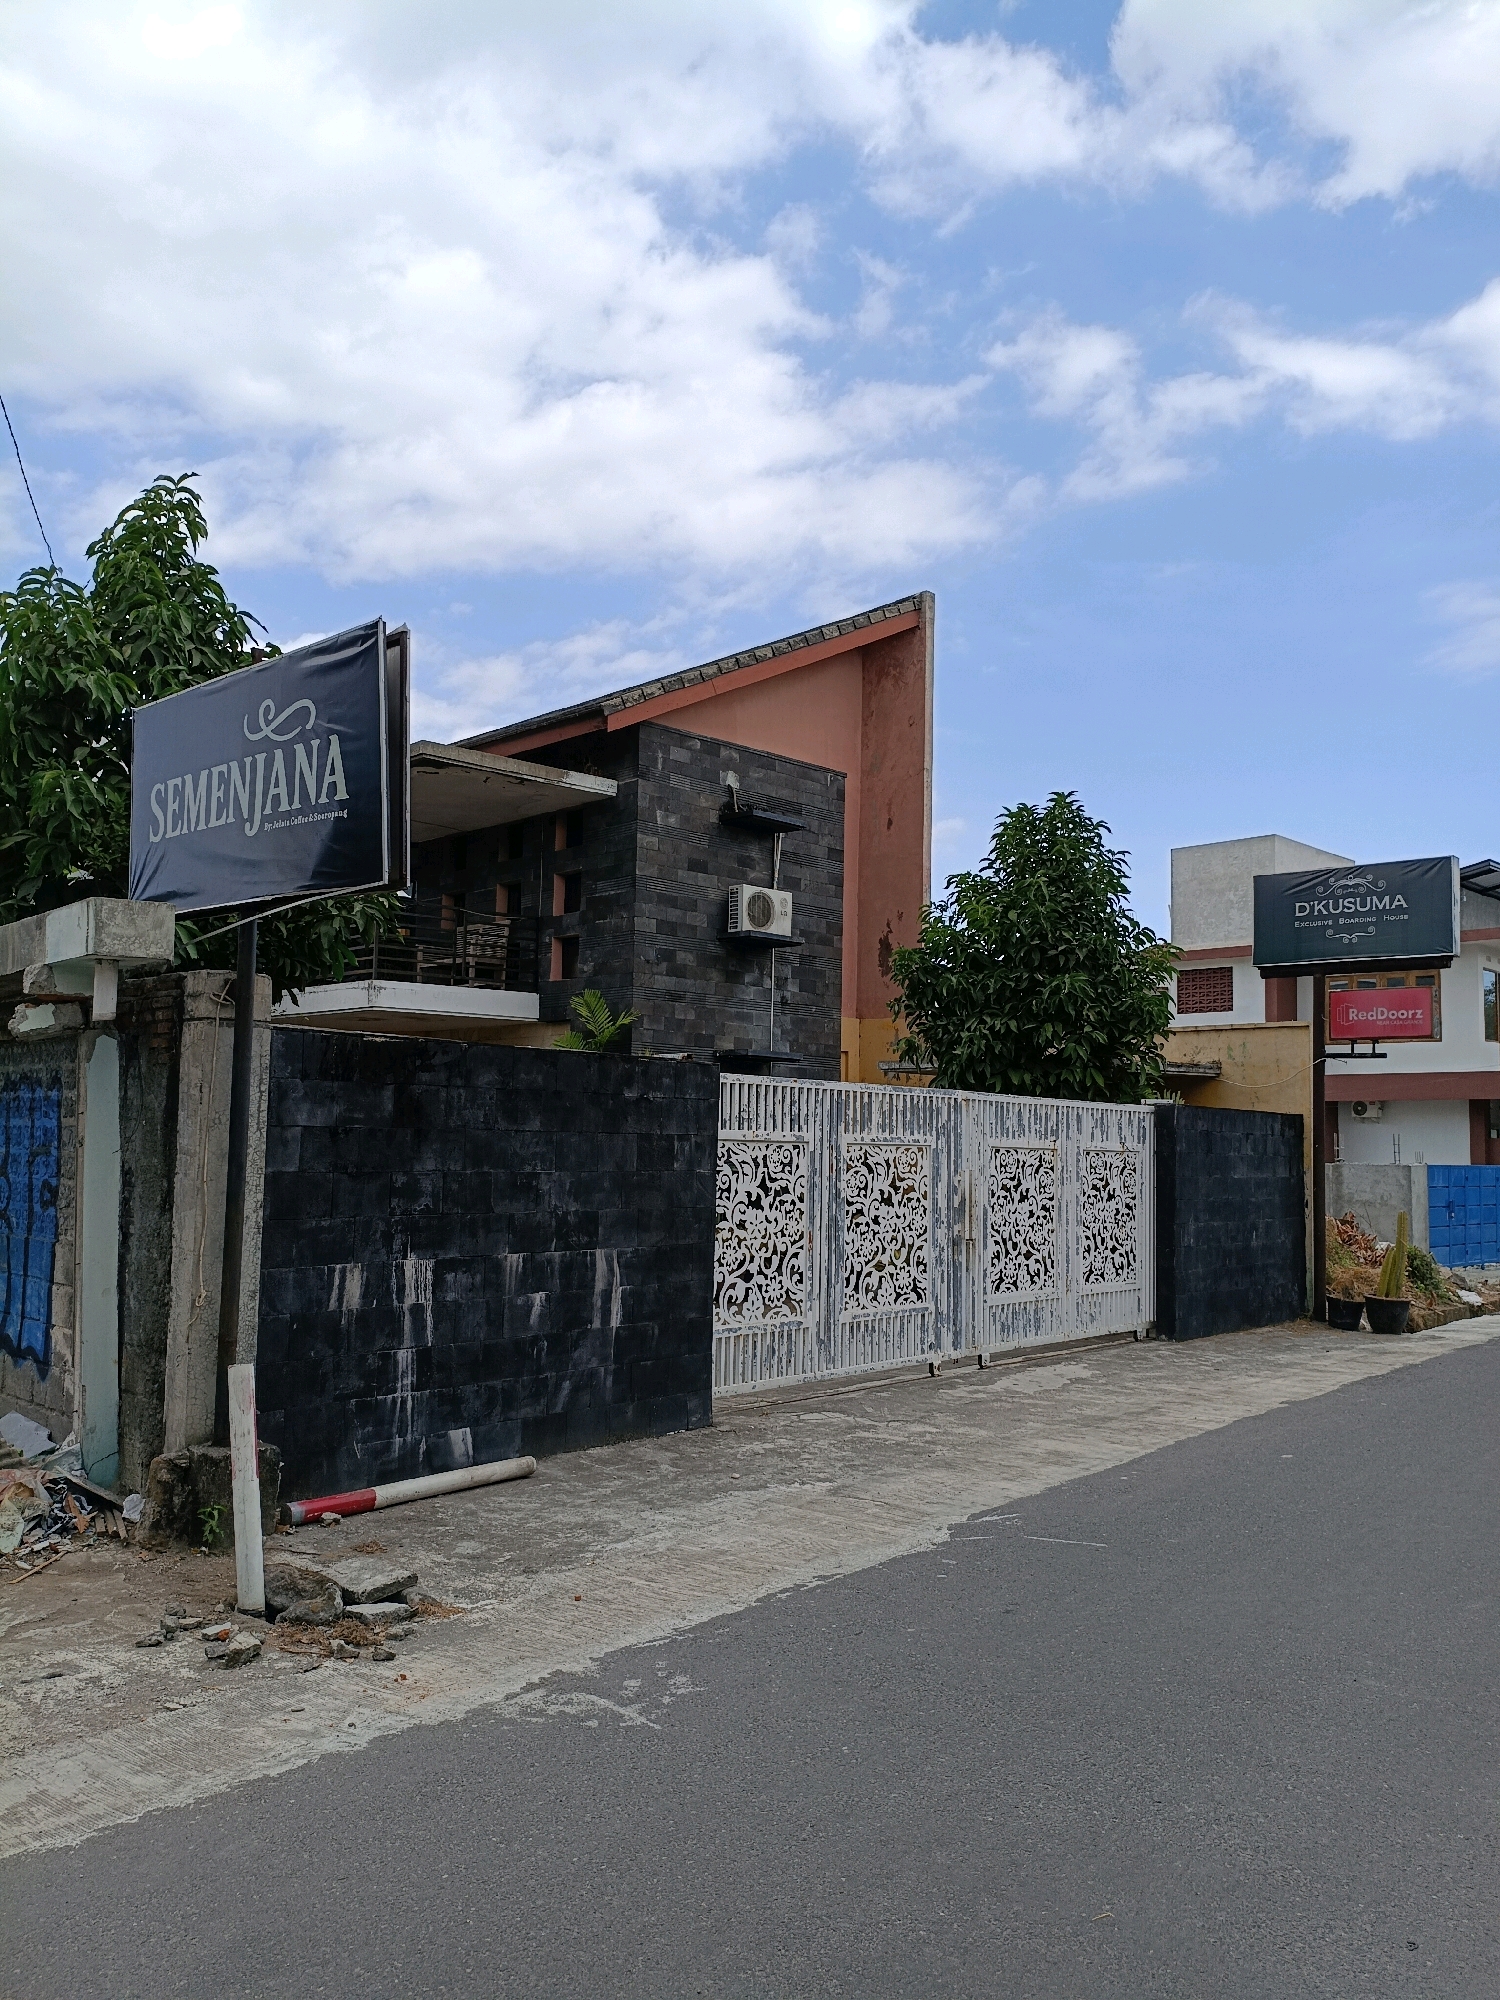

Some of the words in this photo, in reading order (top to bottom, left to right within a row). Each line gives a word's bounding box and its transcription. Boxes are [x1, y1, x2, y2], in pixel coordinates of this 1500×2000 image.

[149, 734, 350, 843] SEMENJANA
[1295, 894, 1408, 917] D'KUSUMA
[1294, 919, 1333, 928] EXCLUSIVE
[1339, 917, 1377, 925] BOARDING
[1383, 914, 1409, 922] HOUSE
[1348, 1006, 1423, 1021] RedDoorz
